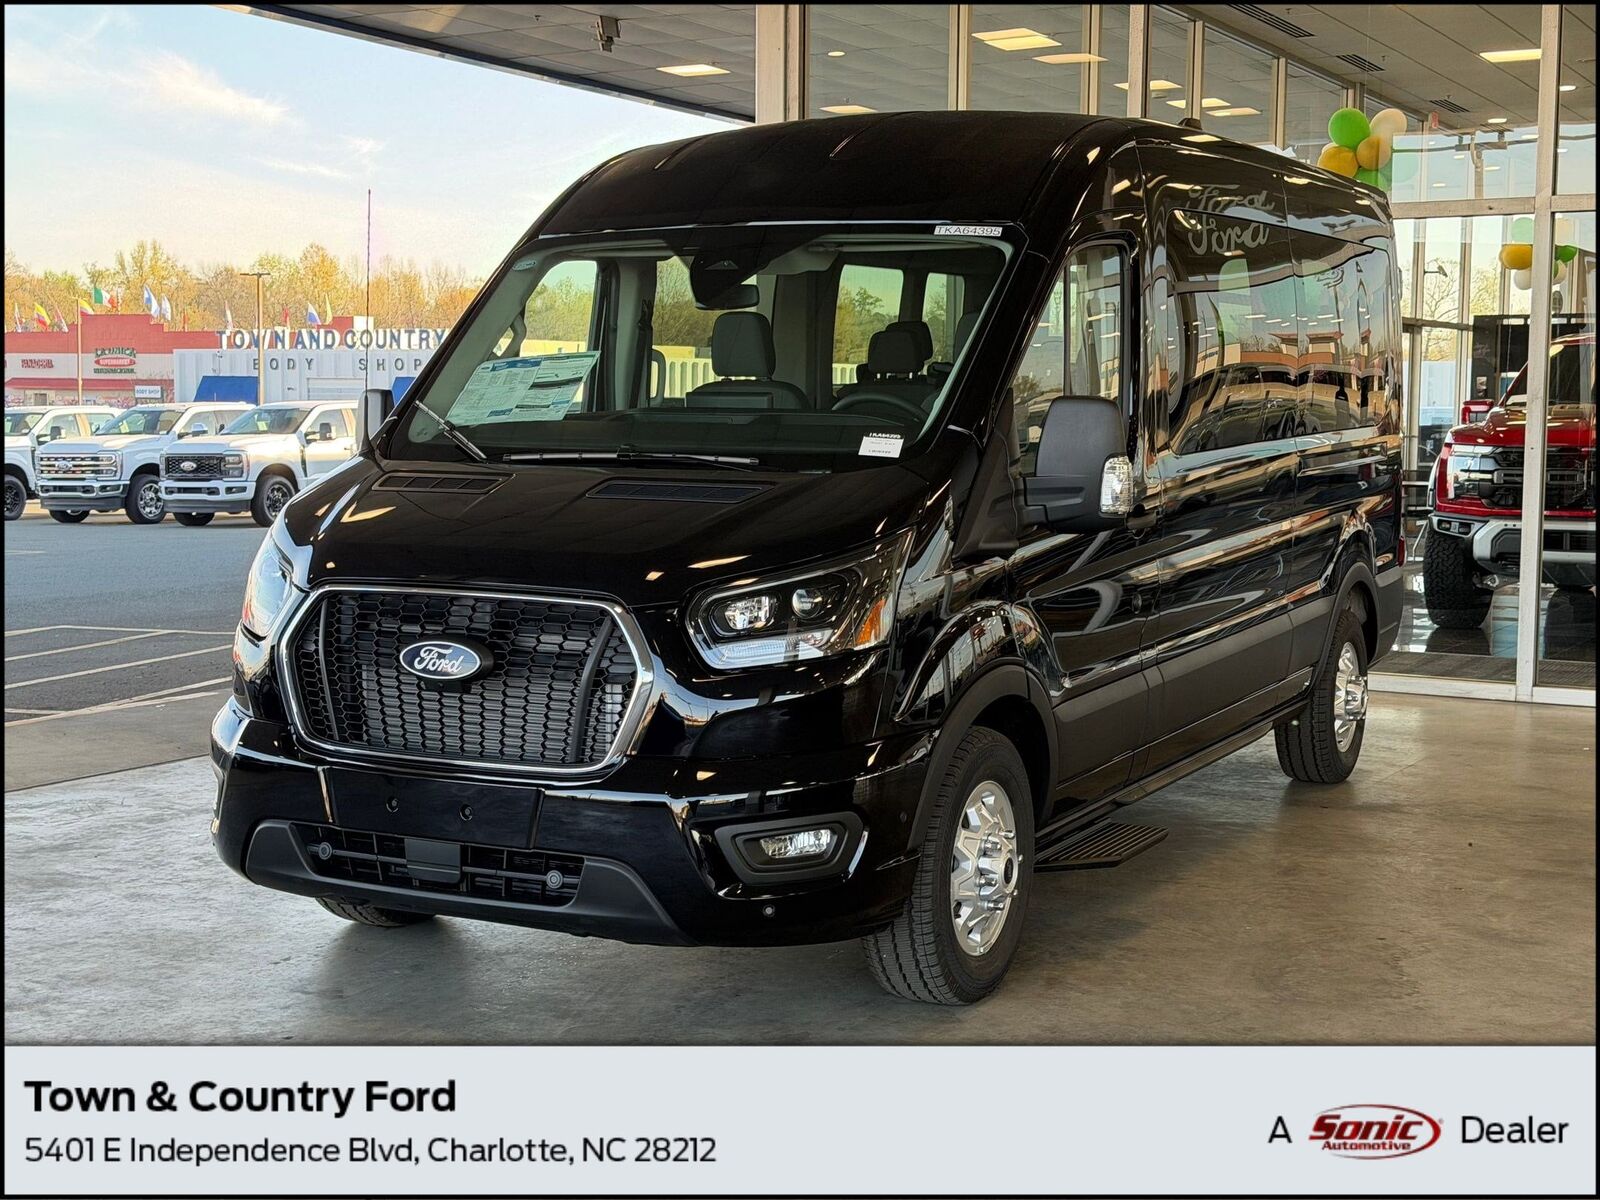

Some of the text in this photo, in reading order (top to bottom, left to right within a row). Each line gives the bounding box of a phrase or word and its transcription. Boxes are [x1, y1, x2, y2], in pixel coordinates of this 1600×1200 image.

[937, 226, 1001, 236] TKA64395
[216, 329, 446, 349] TOWN AND COUNTRY
[252, 357, 422, 371] BODY SHOP
[414, 646, 465, 673] Ford
